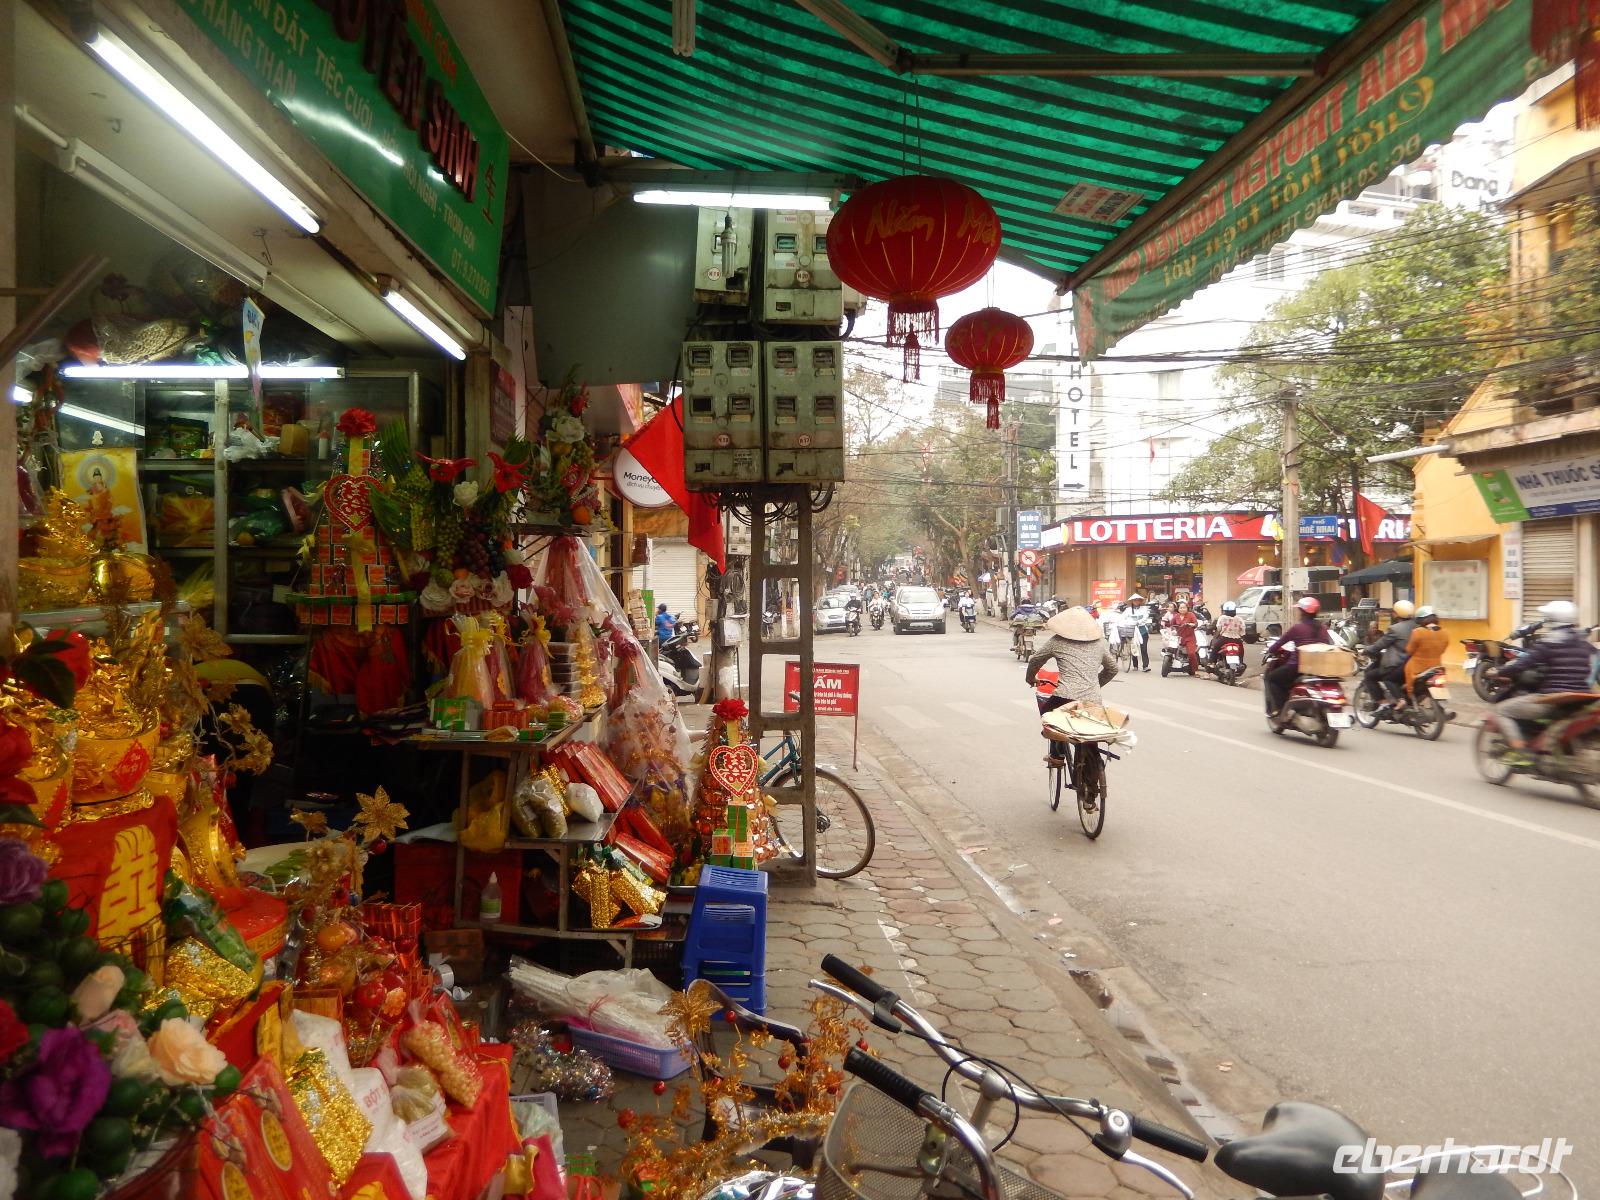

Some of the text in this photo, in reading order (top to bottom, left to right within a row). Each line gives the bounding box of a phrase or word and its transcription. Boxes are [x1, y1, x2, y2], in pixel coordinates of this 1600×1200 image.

[1451, 170, 1498, 197] Dang
[1067, 364, 1084, 470] HOTEL
[1073, 516, 1233, 542] LOTTERIA
[813, 674, 843, 690] ẤM
